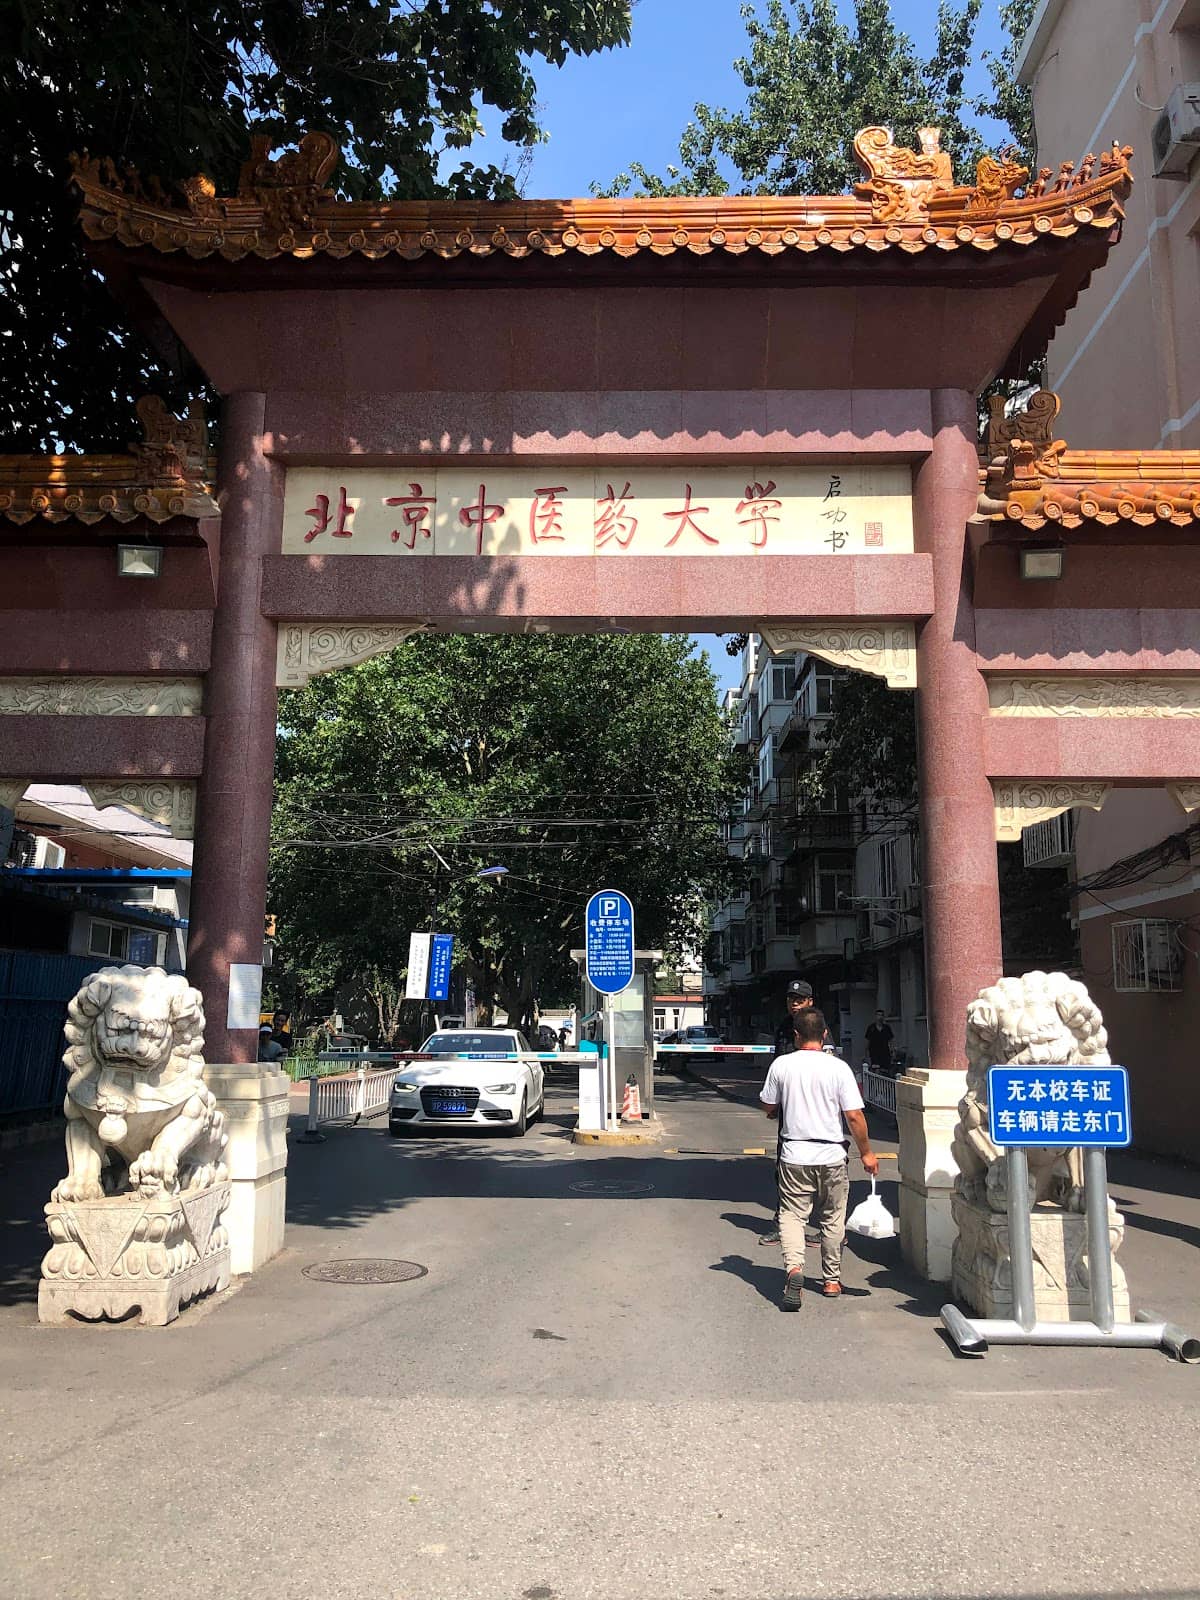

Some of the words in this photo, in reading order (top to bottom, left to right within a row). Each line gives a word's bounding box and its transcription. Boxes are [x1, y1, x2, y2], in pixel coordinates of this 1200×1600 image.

[303, 479, 784, 555] 北京中医药大学
[820, 475, 849, 553] 启功书
[604, 900, 616, 916] P
[1007, 1079, 1112, 1102] 无本校车证
[997, 1109, 1123, 1133] 车辆请走东门
